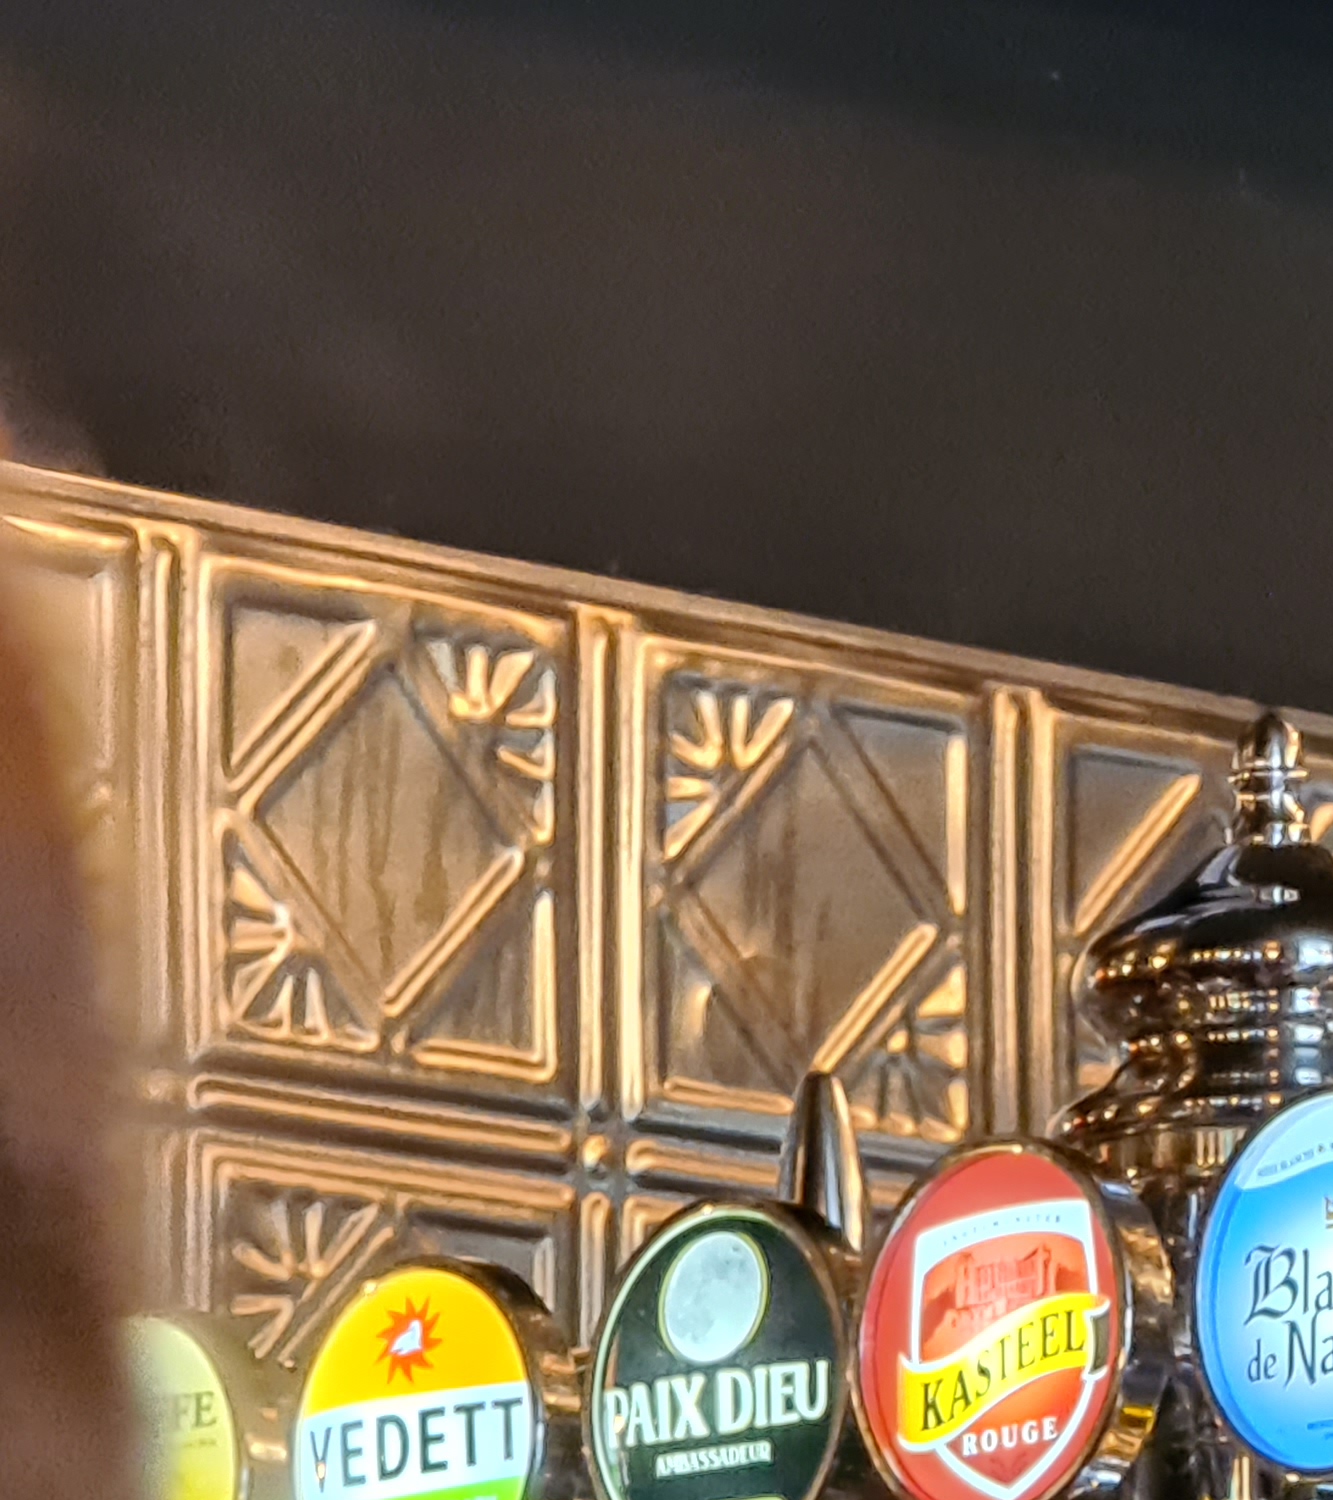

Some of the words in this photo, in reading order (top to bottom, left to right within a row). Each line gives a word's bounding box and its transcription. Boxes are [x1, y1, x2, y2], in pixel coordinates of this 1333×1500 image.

[919, 1308, 1087, 1433] KASTEEL
[1246, 1339, 1277, 1384] de
[605, 1372, 710, 1448] PAIX
[716, 1359, 831, 1433] DIEU
[962, 1415, 1060, 1458] ROUGE
[308, 1396, 524, 1493] VEDETT
[656, 1440, 772, 1479] AMBASSADEUR
